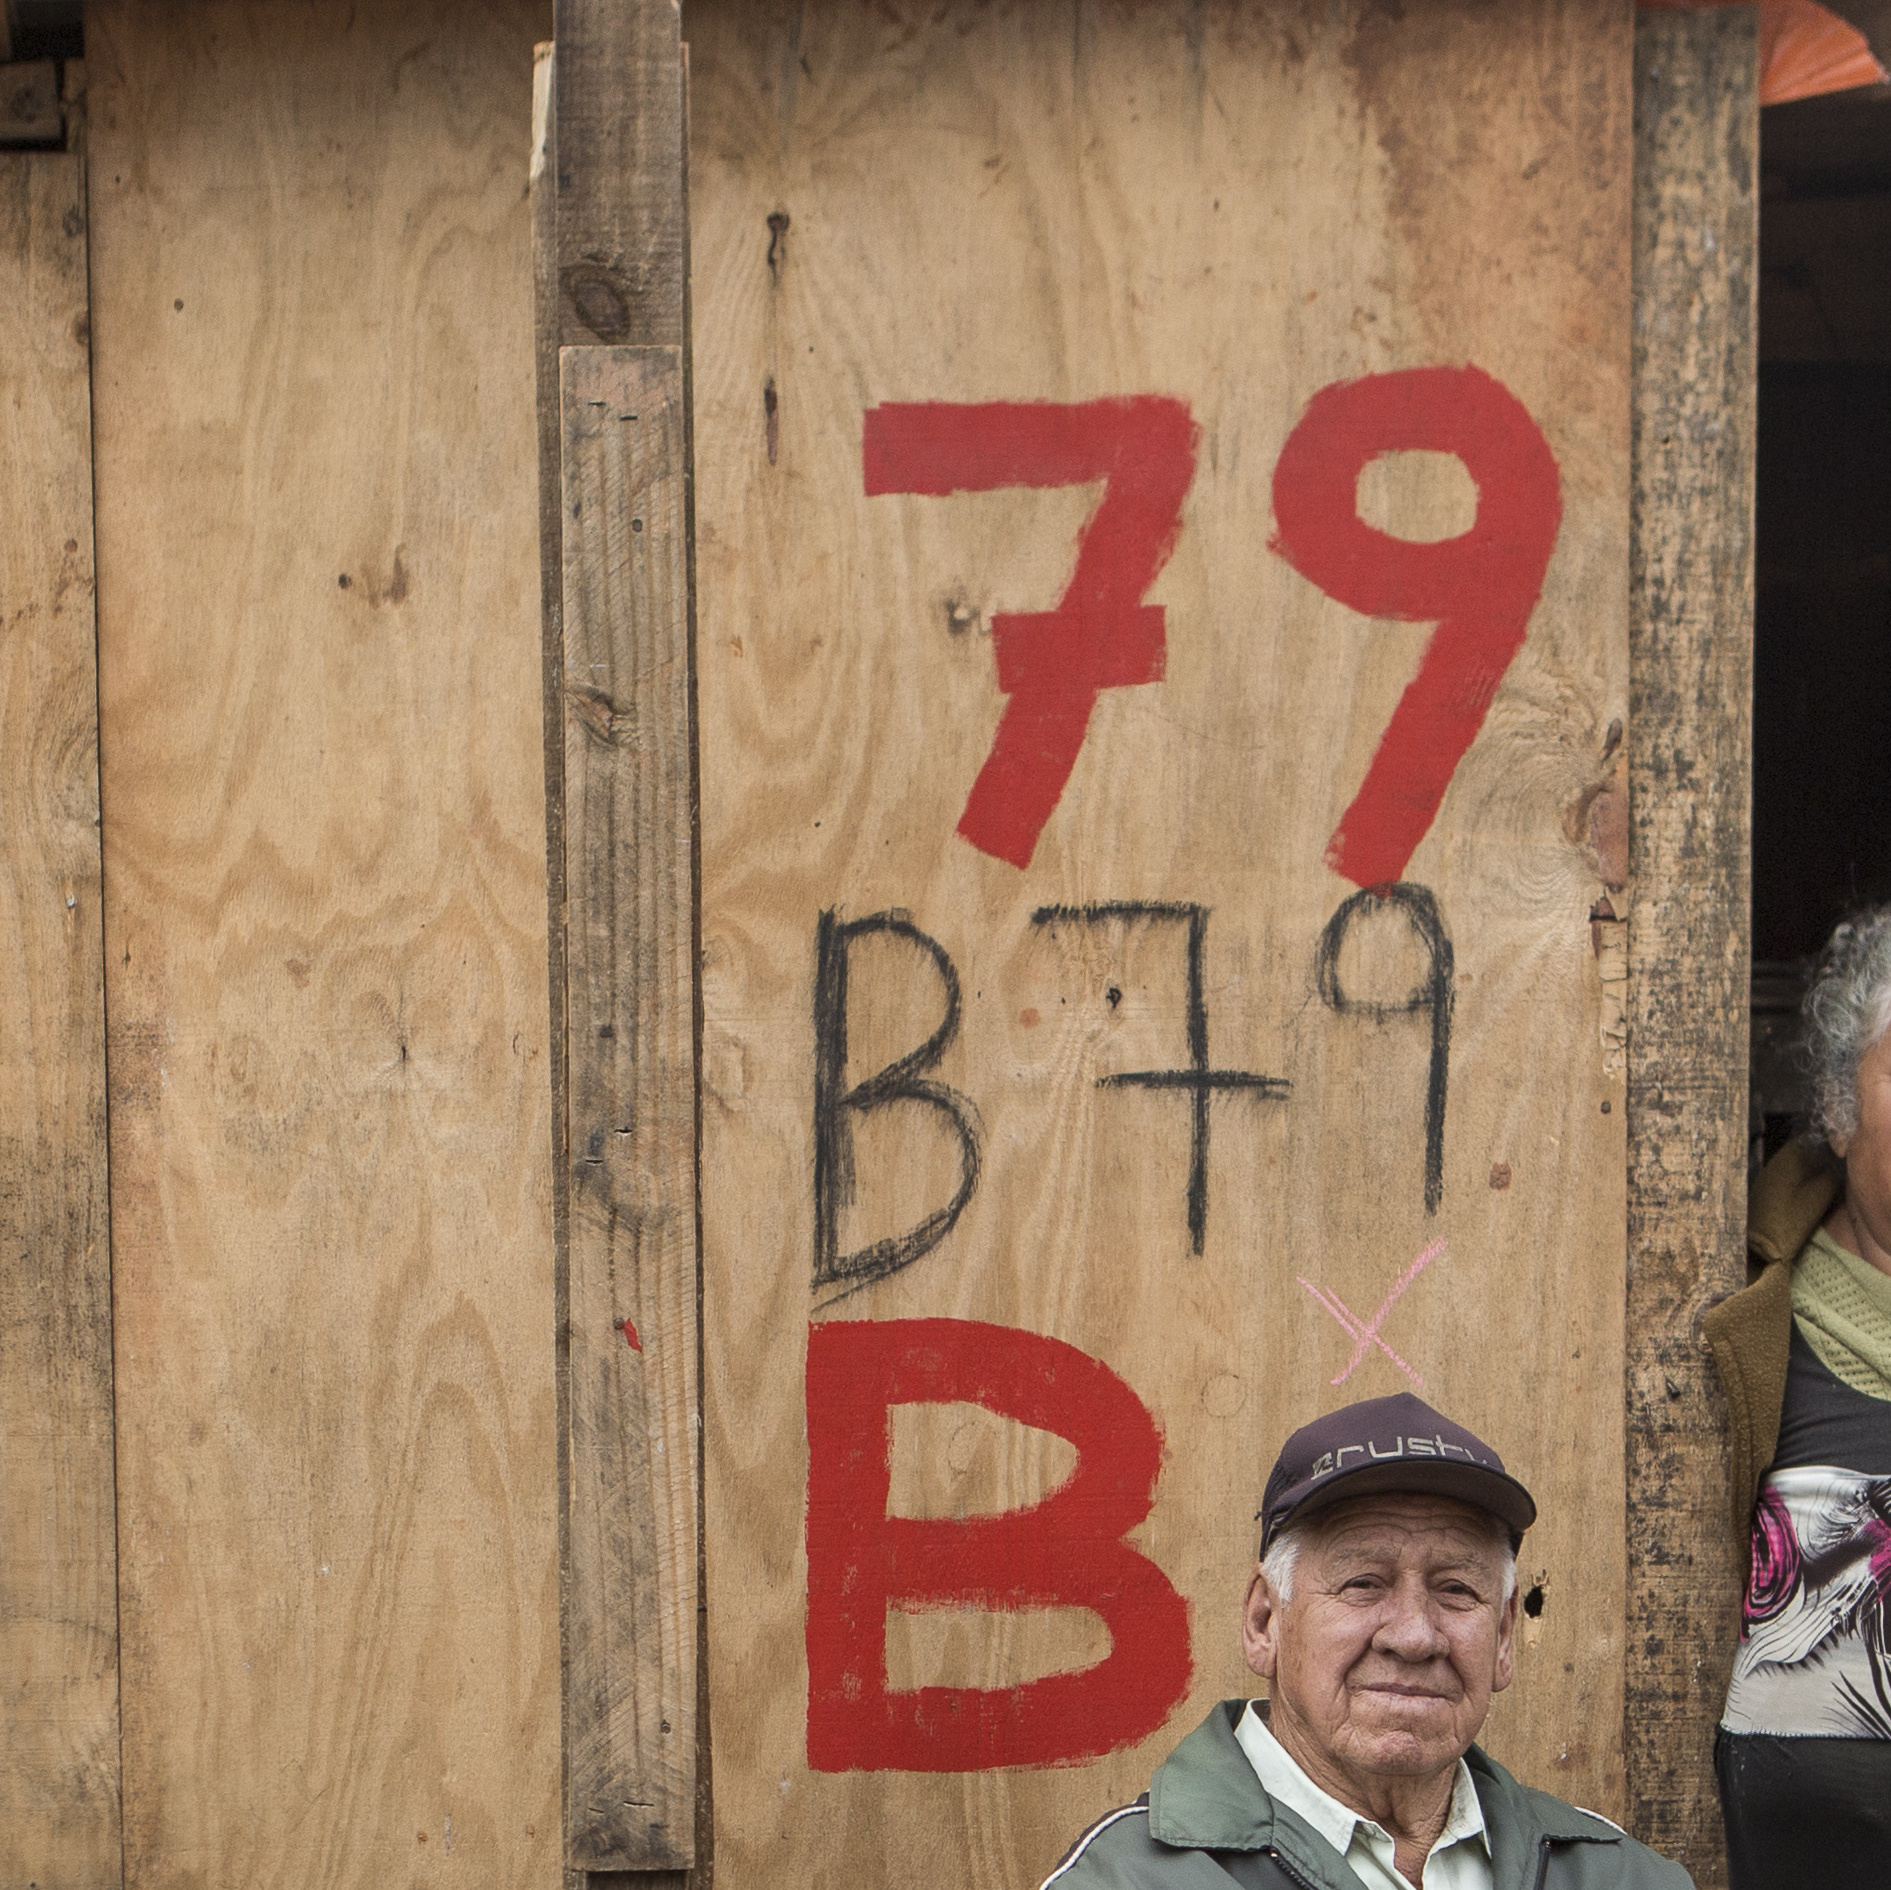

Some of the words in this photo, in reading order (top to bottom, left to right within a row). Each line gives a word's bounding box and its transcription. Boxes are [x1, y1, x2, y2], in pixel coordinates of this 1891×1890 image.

[862, 362, 1564, 892] 79
[810, 882, 1456, 1311] B79
[805, 1317, 1195, 1773] B
